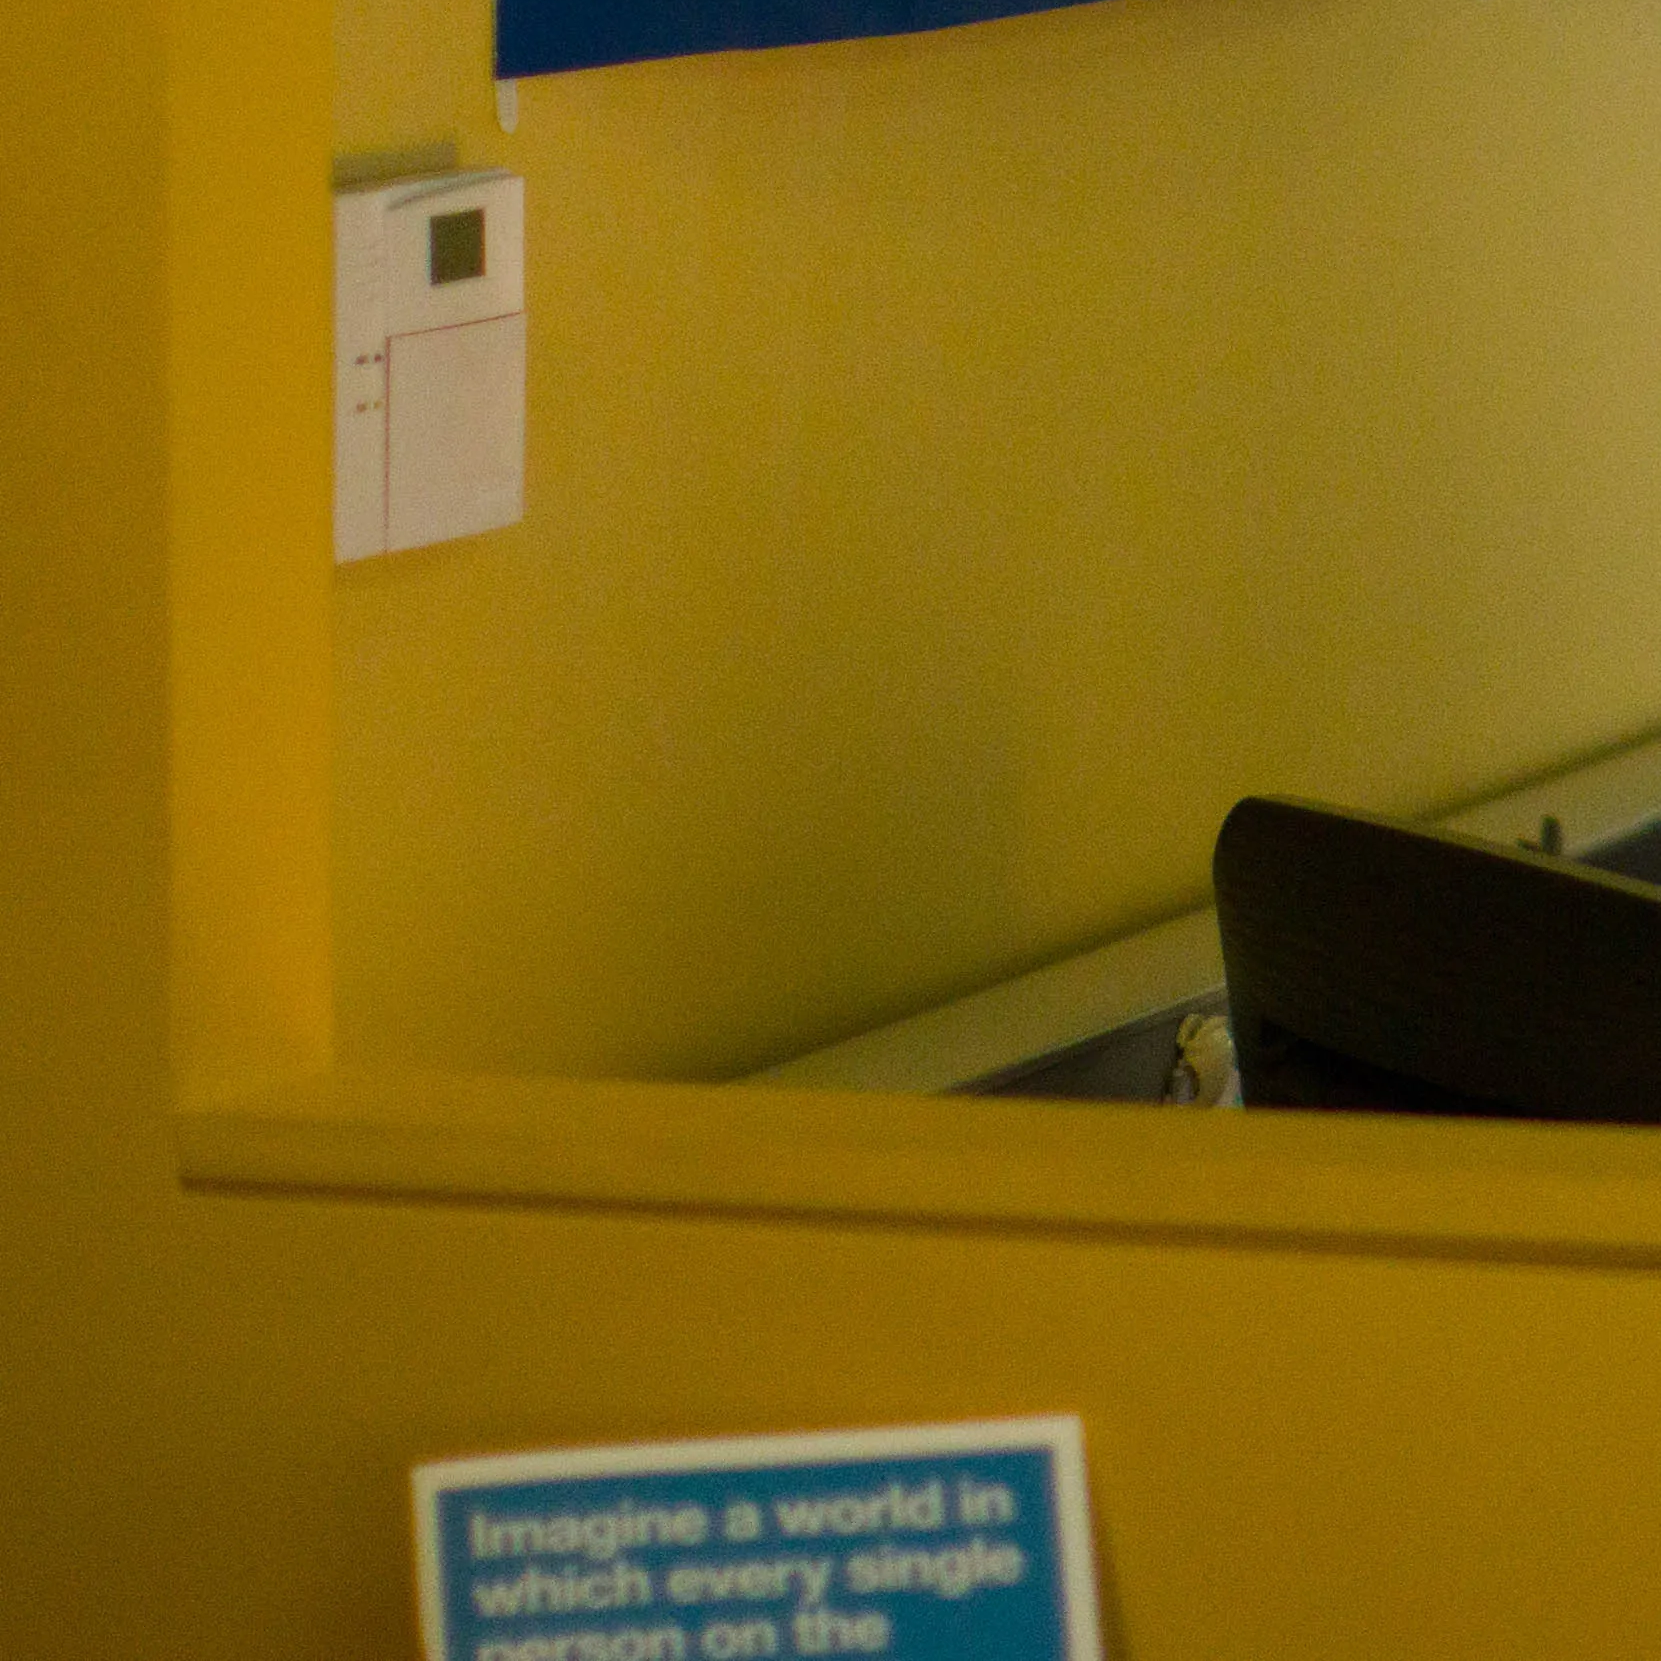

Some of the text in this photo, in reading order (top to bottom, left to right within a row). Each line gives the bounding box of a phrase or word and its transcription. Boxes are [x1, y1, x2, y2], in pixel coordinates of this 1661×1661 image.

[472, 1479, 1014, 1556] Imagine a world in
[474, 1537, 1024, 1618] which every single
[703, 1617, 778, 1660] on
[794, 1608, 890, 1655] the
